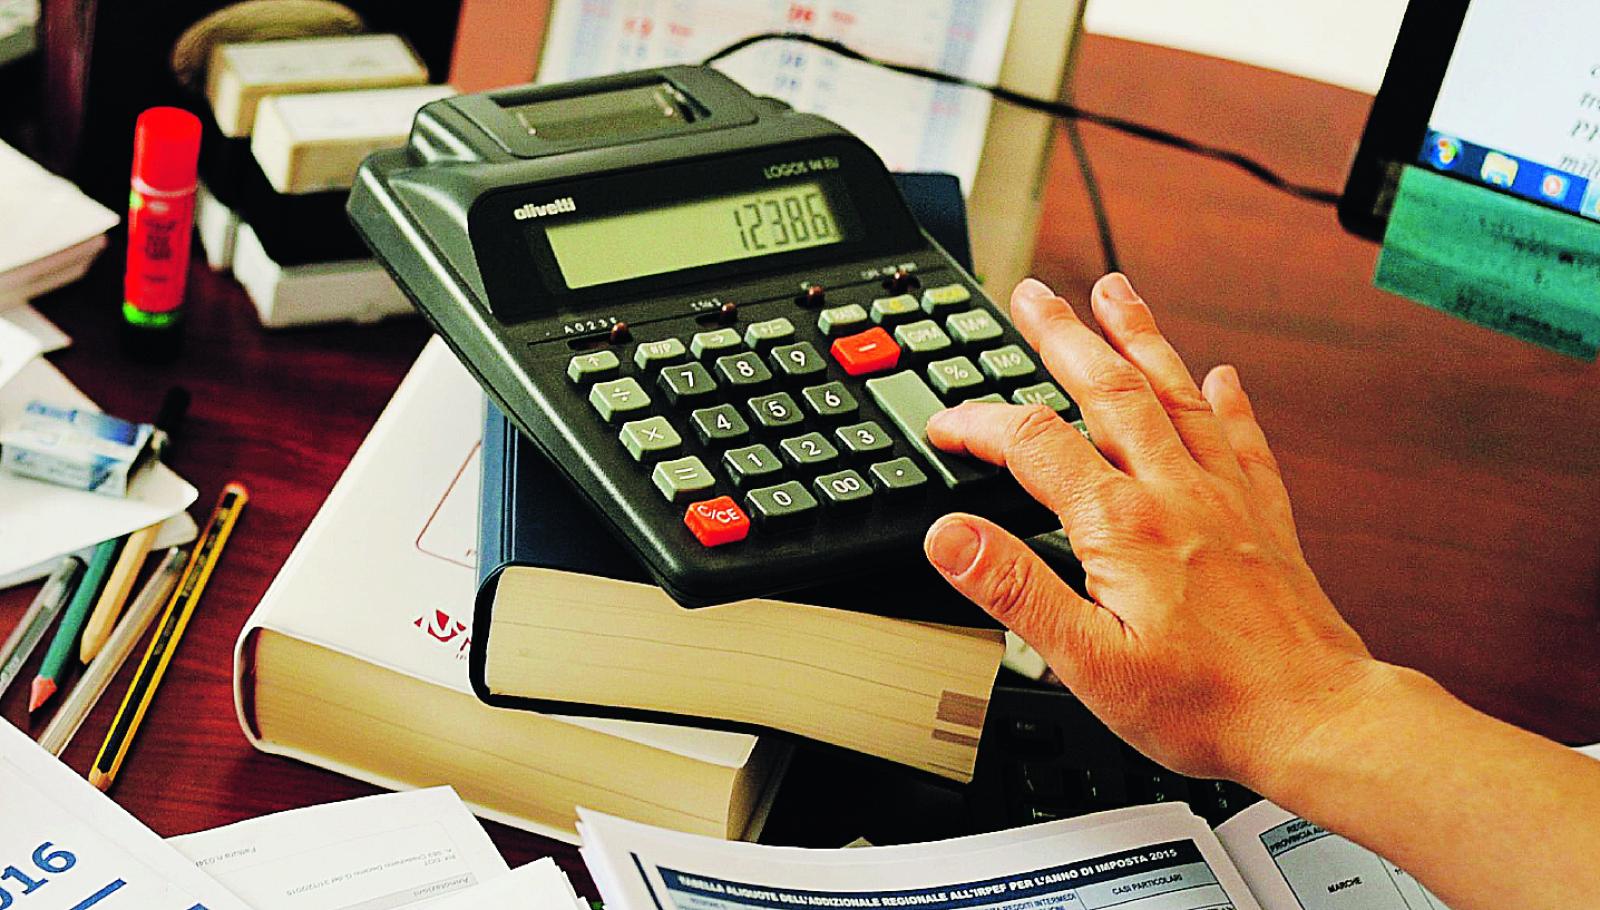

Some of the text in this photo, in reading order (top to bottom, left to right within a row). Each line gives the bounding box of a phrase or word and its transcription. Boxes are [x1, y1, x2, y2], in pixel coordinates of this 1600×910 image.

[763, 161, 808, 179] LOGOS
[513, 197, 576, 220] olivetti
[733, 193, 830, 251] 12386
[789, 349, 806, 367] 9
[735, 359, 755, 378] 8
[680, 370, 695, 388] 7
[824, 389, 841, 408] 6
[767, 400, 787, 418] 5
[716, 413, 732, 430] 4
[856, 429, 875, 445] 3
[801, 439, 821, 457] 2
[747, 452, 764, 468] 1
[831, 476, 860, 493] 00
[772, 490, 792, 507] 0
[696, 504, 741, 524] C/CE
[0, 841, 77, 910] 16
[881, 892, 948, 907] REGIONALE
[950, 883, 1007, 900] ALL'IRPEF
[1009, 879, 1034, 891] PER
[1034, 870, 1079, 887] L'ANNO
[1080, 865, 1094, 876] DI
[1095, 854, 1148, 873] IMPOSTA
[1149, 848, 1178, 861] 2015
[1111, 873, 1183, 896] CASI PARTICOLARI
[1327, 876, 1364, 894] MARCHE
